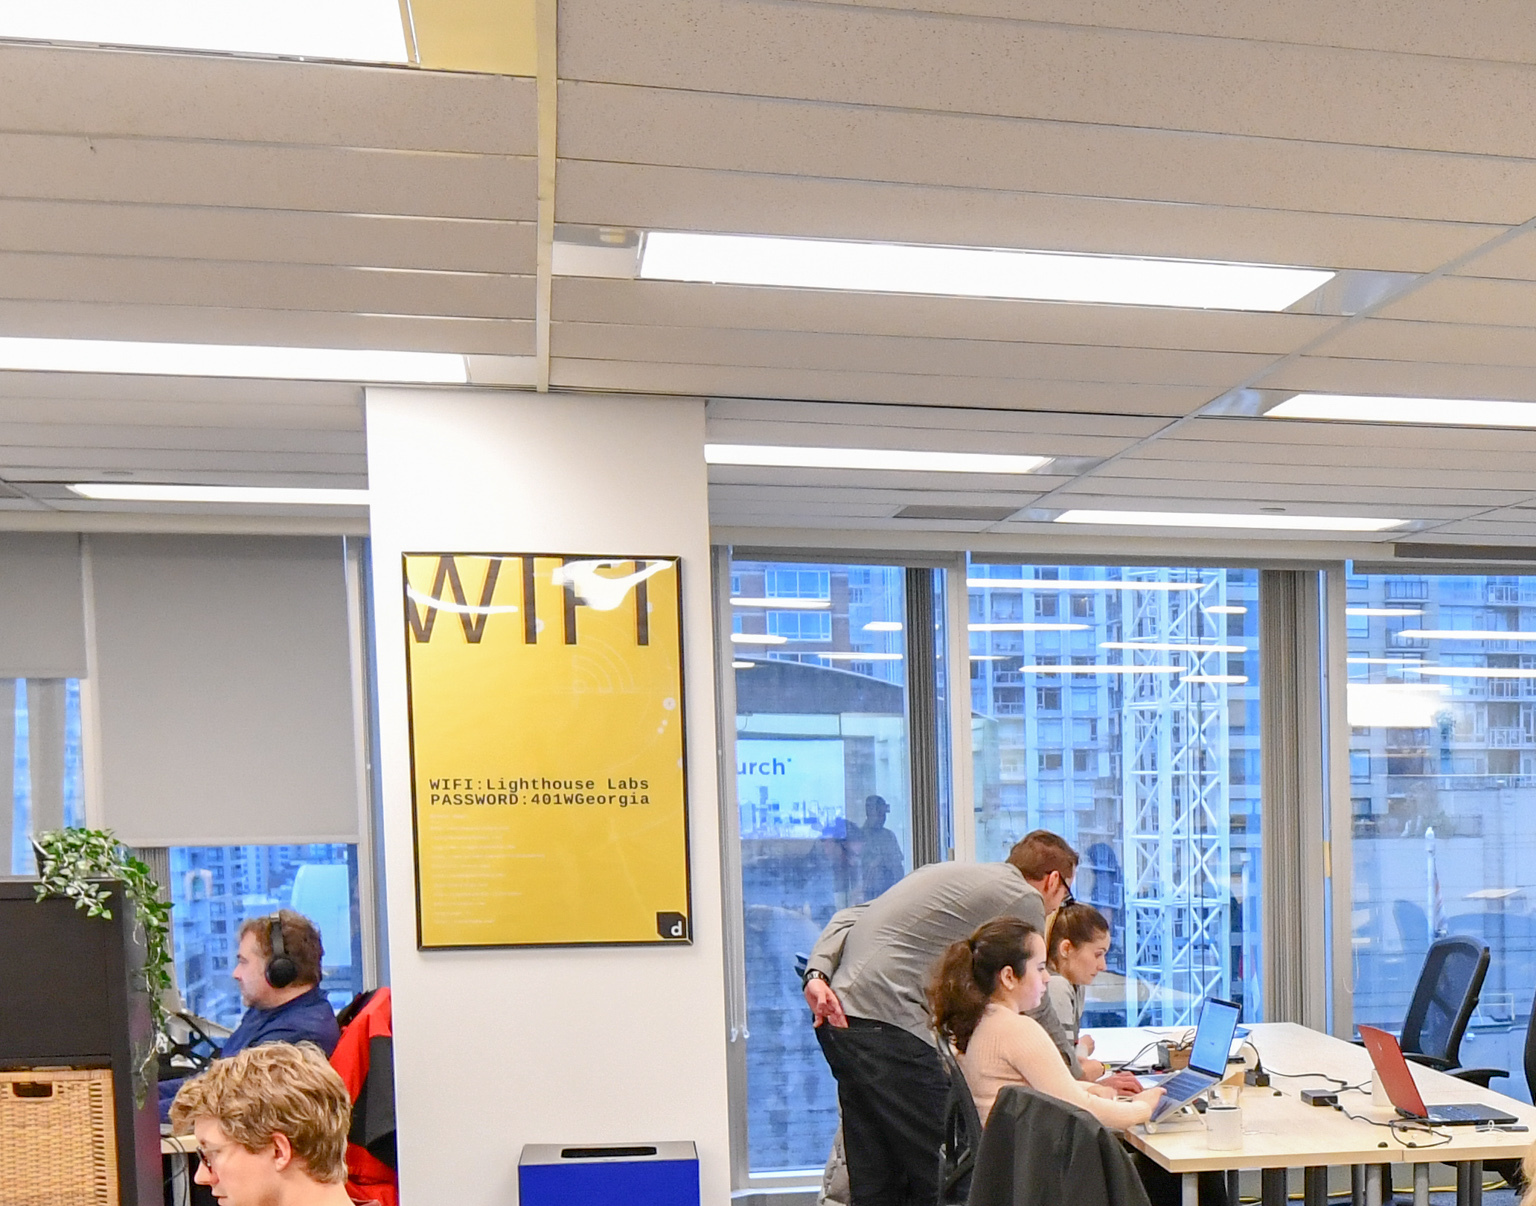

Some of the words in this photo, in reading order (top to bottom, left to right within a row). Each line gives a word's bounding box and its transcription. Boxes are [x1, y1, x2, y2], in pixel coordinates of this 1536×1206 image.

[429, 777, 595, 793] WIFI:Lighthouse
[607, 777, 649, 790] Labs
[430, 793, 650, 808] PASSWORD:401WGeorgia
